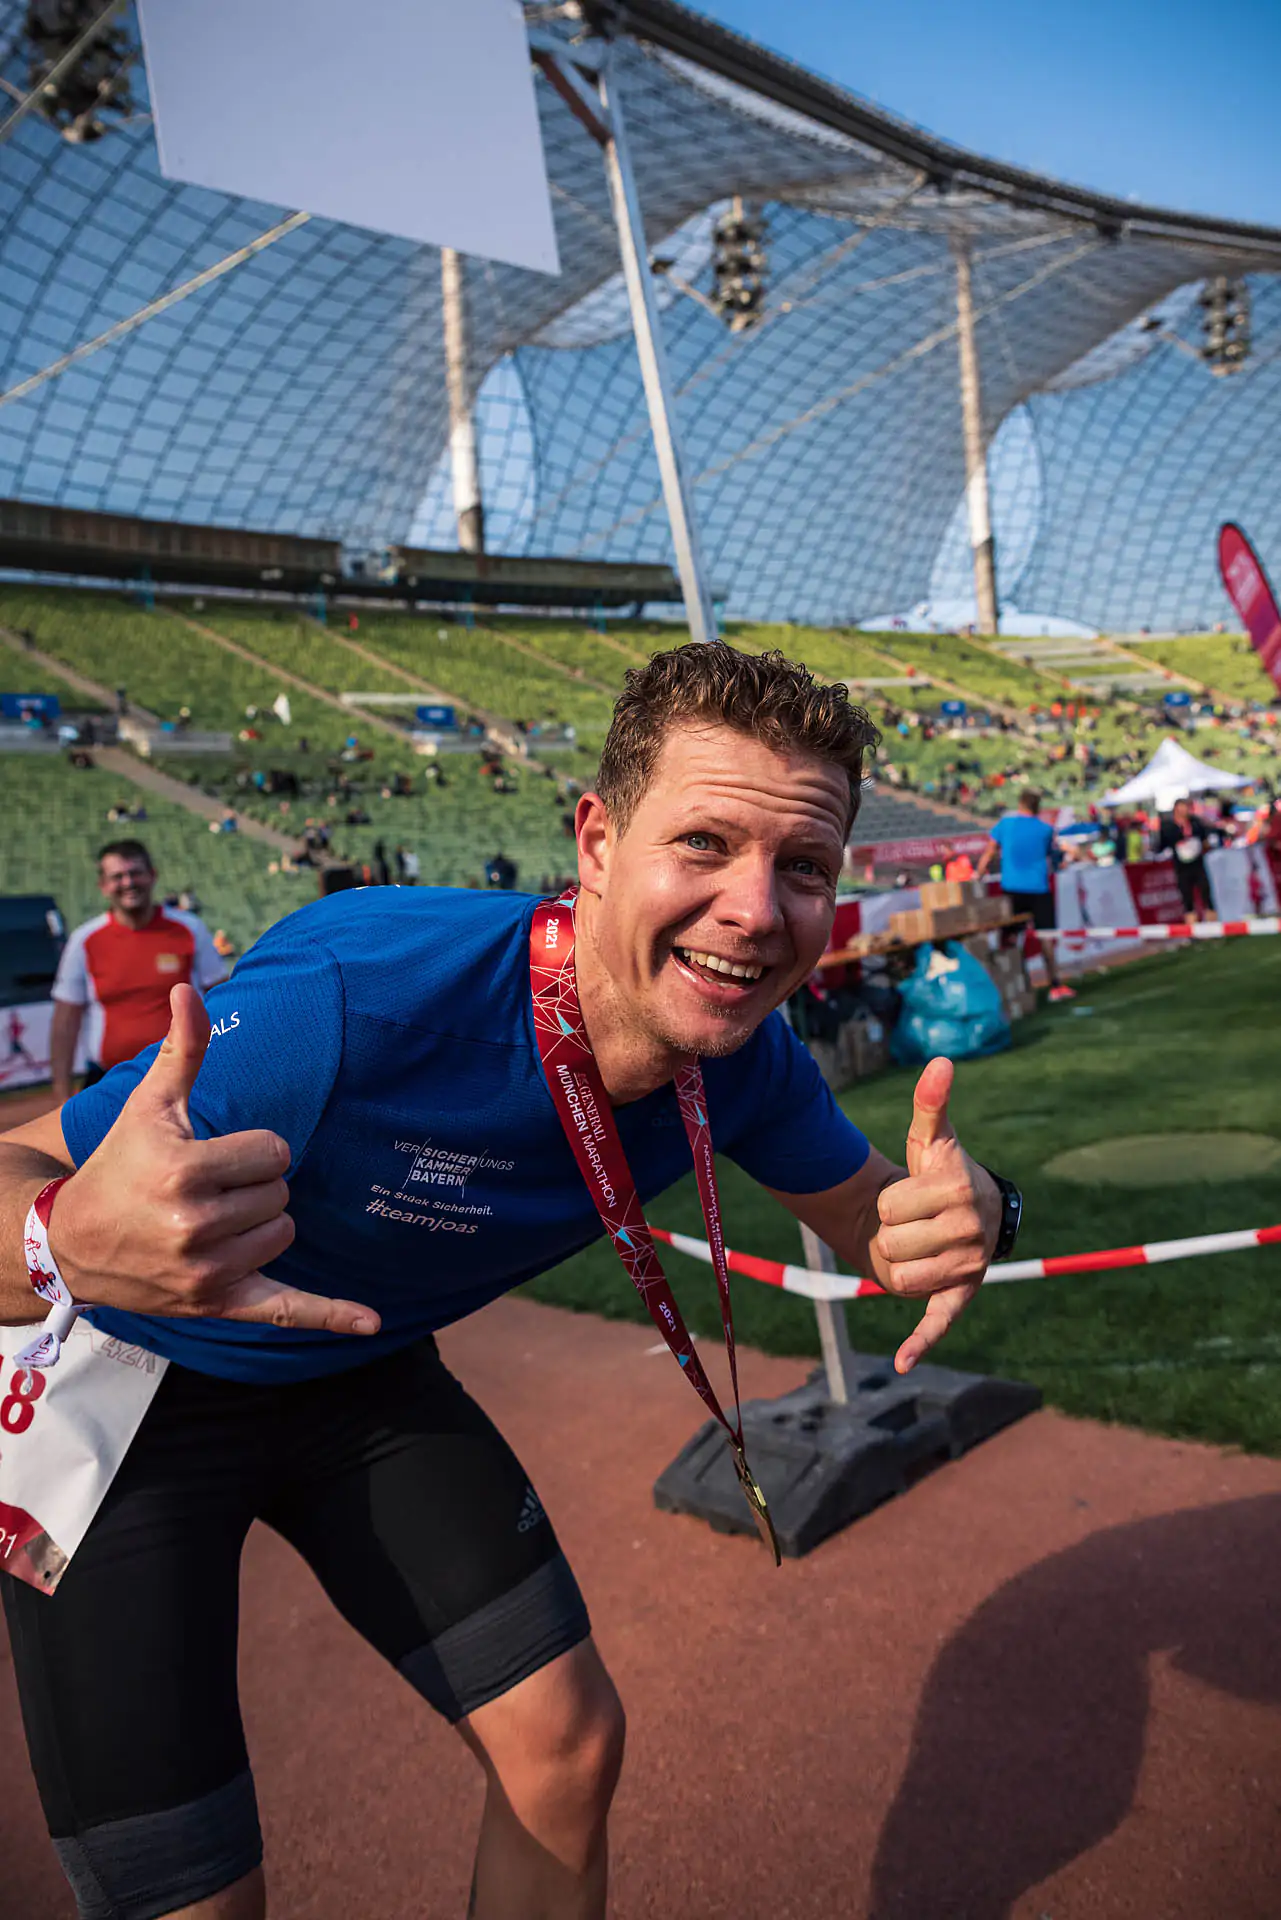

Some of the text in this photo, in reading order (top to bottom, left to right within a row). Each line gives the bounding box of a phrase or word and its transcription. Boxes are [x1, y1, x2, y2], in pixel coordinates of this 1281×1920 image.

[545, 918, 559, 949] 2021
[206, 1011, 241, 1048] ALS
[580, 1085, 606, 1141] GENERALI
[556, 1064, 617, 1208] MÜNCHEN MARATHON
[411, 1170, 465, 1187] BAYERN
[416, 1157, 471, 1176] KAMMER
[365, 1198, 479, 1234] #teamjoas
[370, 1184, 493, 1216] Ein Stück Sicherheit.
[658, 1301, 677, 1332] 2021
